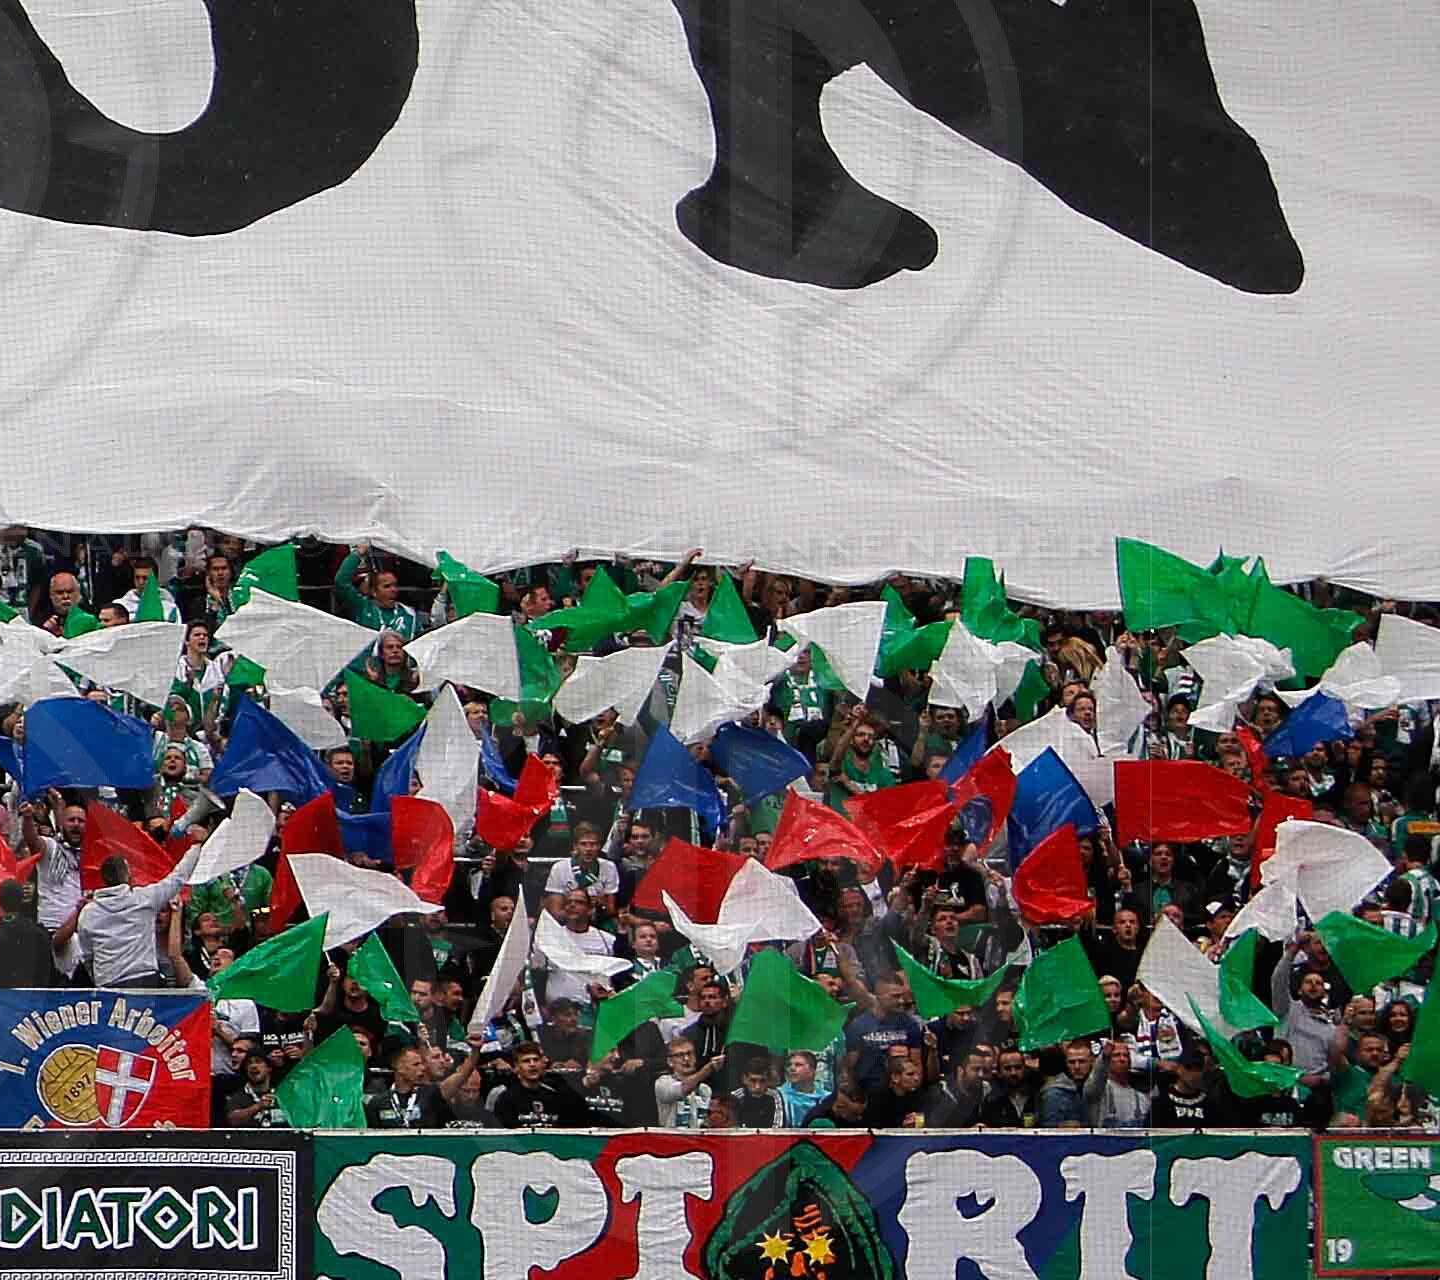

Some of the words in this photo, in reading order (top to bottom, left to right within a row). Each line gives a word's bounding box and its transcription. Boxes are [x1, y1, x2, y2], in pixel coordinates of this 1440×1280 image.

[11, 1000, 102, 1051] Wiener
[107, 998, 197, 1081] Arbeiter
[63, 1074, 90, 1103] 1897
[1333, 1146, 1431, 1170] GREEN
[1326, 1238, 1353, 1263] 19
